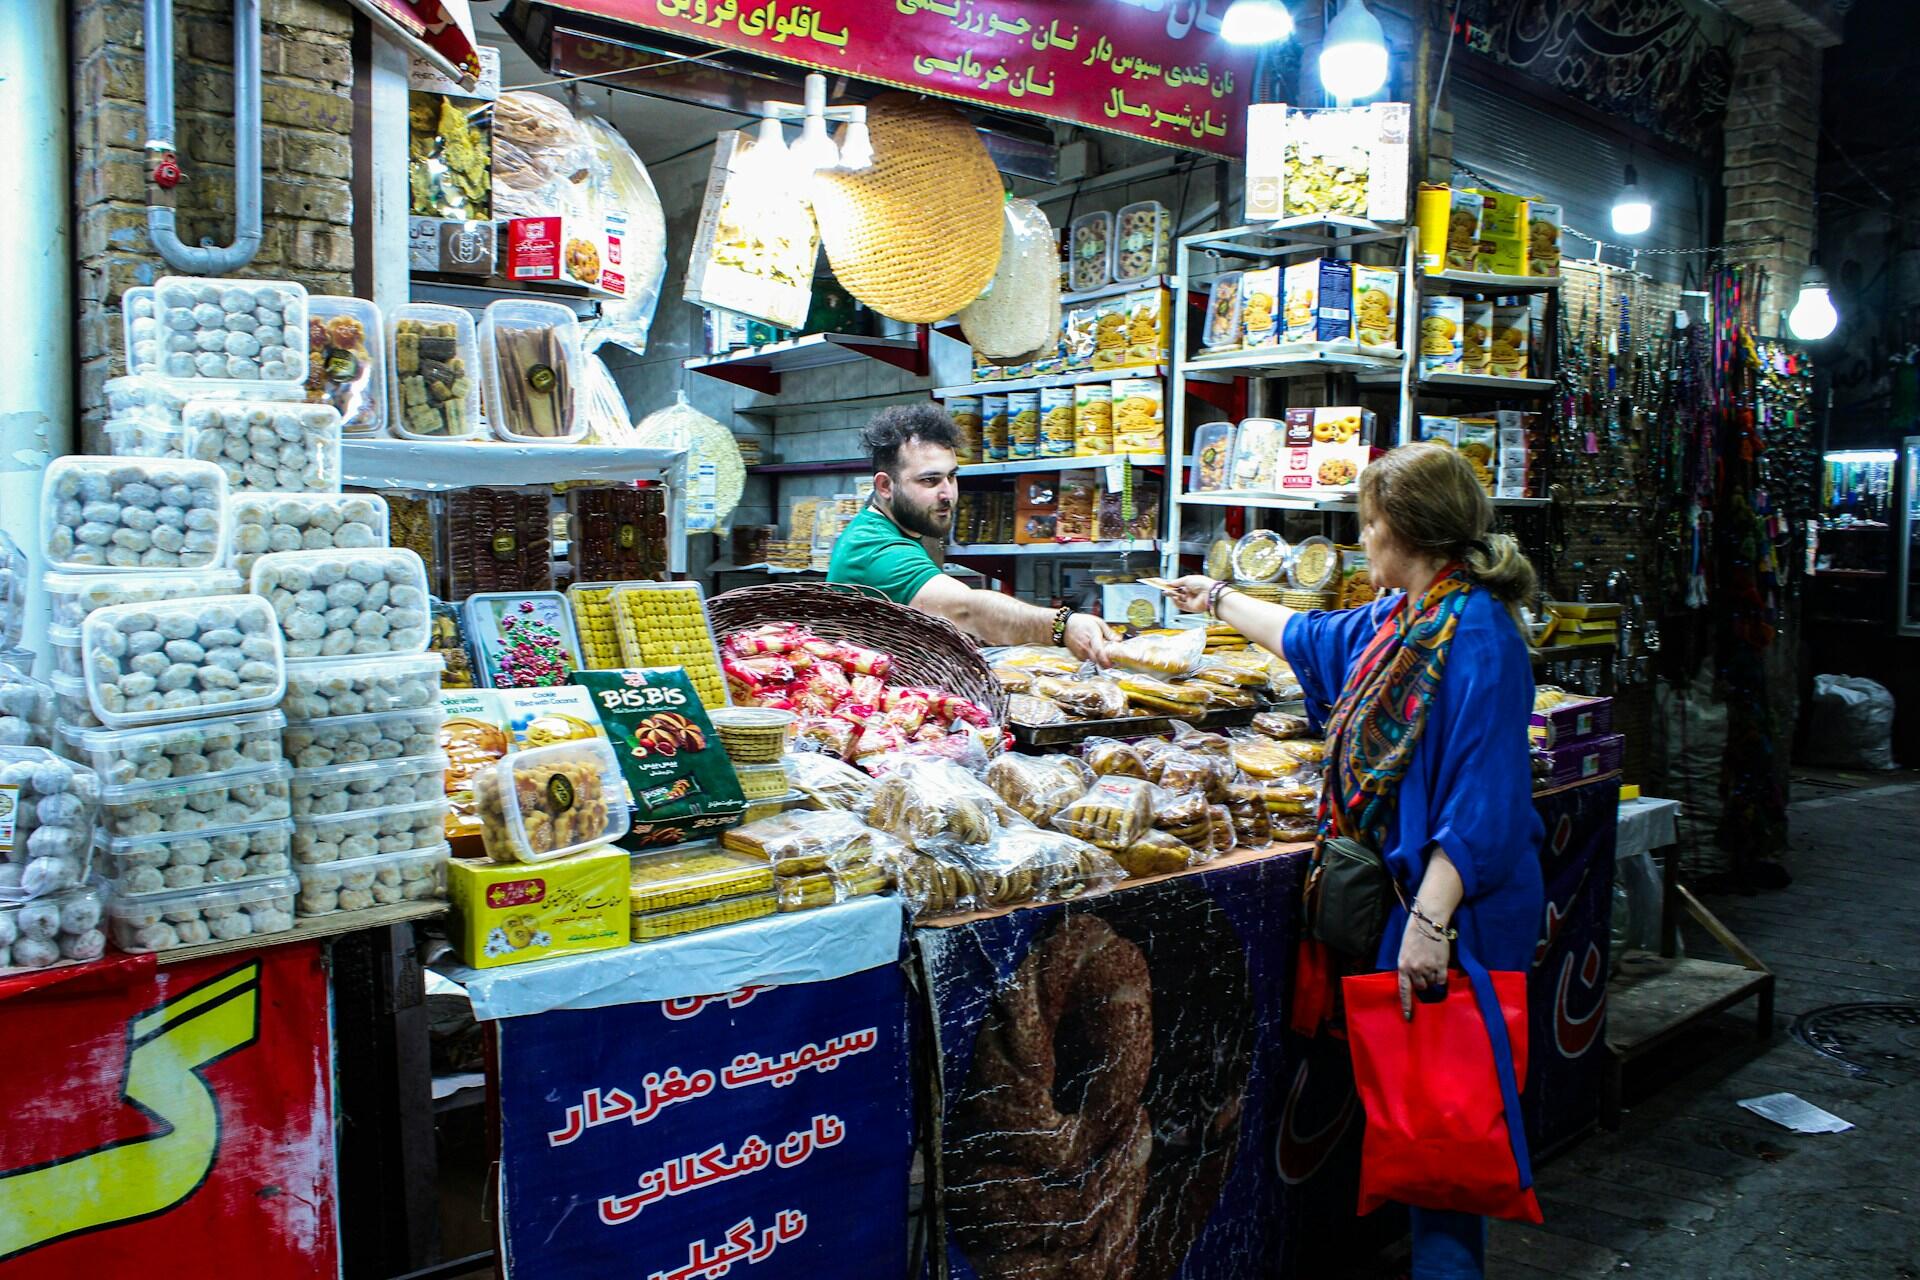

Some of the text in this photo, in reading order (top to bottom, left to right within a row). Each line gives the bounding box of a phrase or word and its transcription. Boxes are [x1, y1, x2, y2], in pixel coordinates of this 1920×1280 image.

[738, 1, 849, 56] باقلوای
[1031, 19, 1079, 51] نان
[913, 49, 1055, 97] نان خرمایی
[1082, 35, 1235, 98] نان قندی سبوس دار
[1190, 110, 1228, 138] نان
[721, 1027, 877, 1090] سیمیت
[599, 1114, 845, 1225] نان شکلاتی
